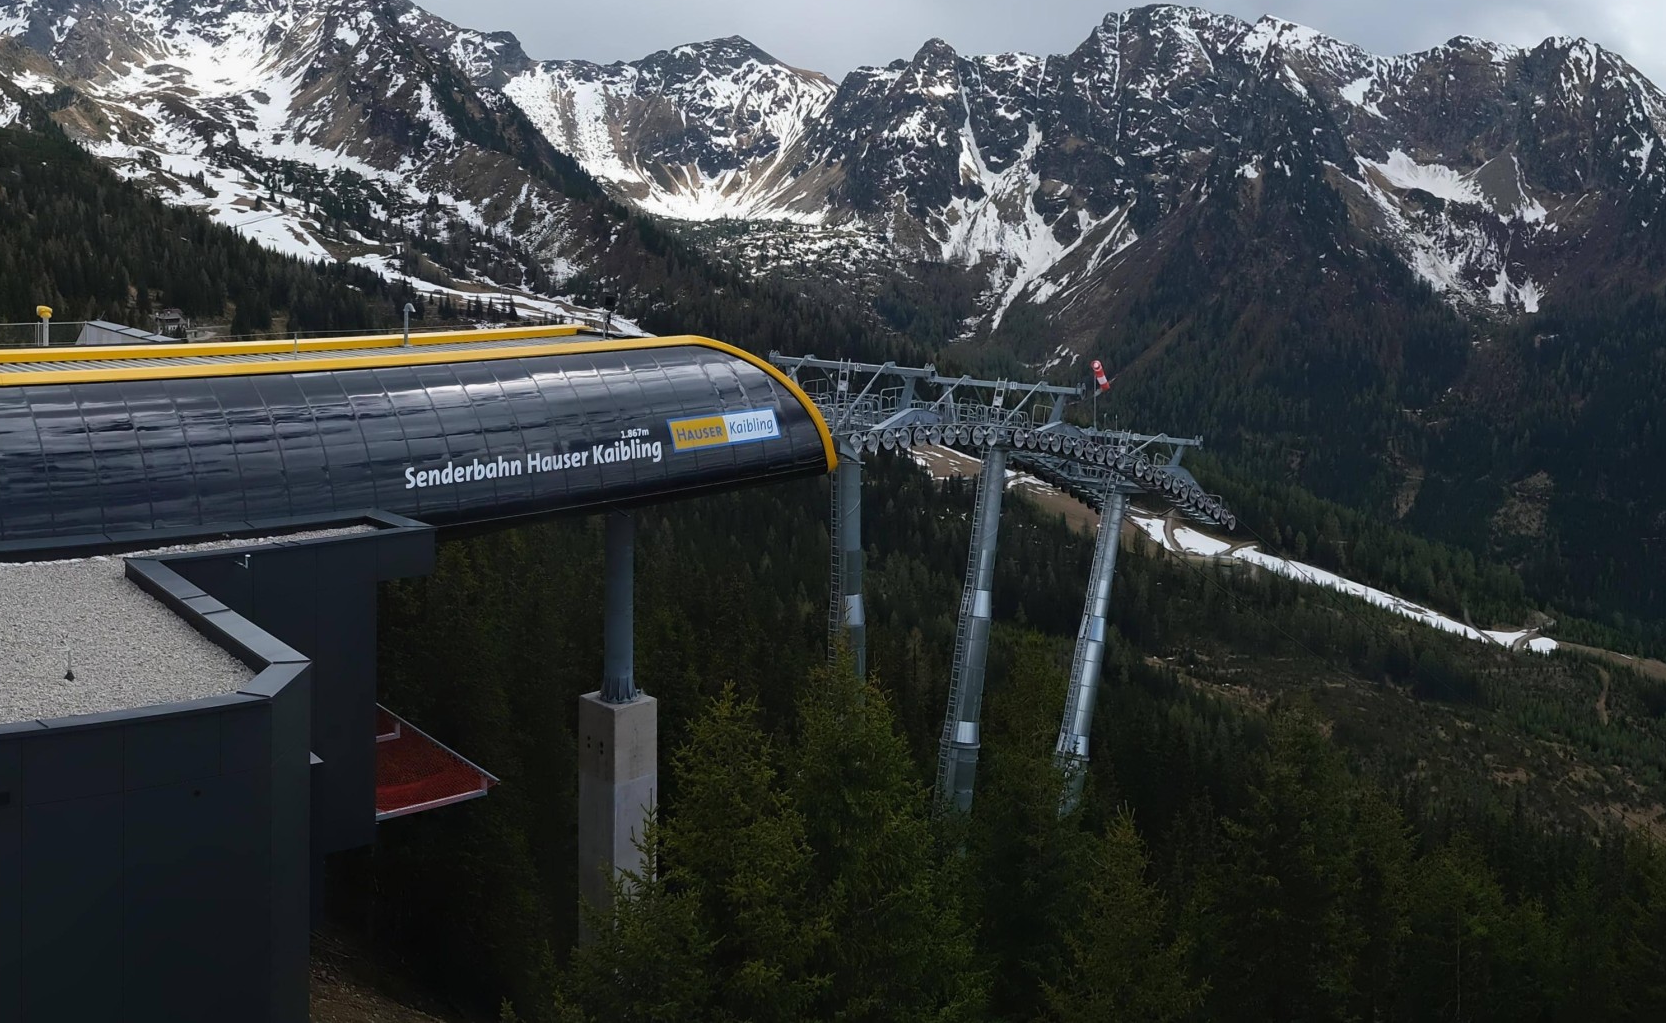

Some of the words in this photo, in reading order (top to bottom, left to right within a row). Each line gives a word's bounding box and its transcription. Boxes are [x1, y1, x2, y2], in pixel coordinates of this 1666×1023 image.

[621, 428, 649, 439] 1.867m
[676, 425, 723, 441] HAUSER
[729, 418, 773, 435] Kaibling
[405, 455, 522, 489] Senderbahn
[527, 449, 589, 473] Hauser
[593, 439, 662, 465] Kaibling
